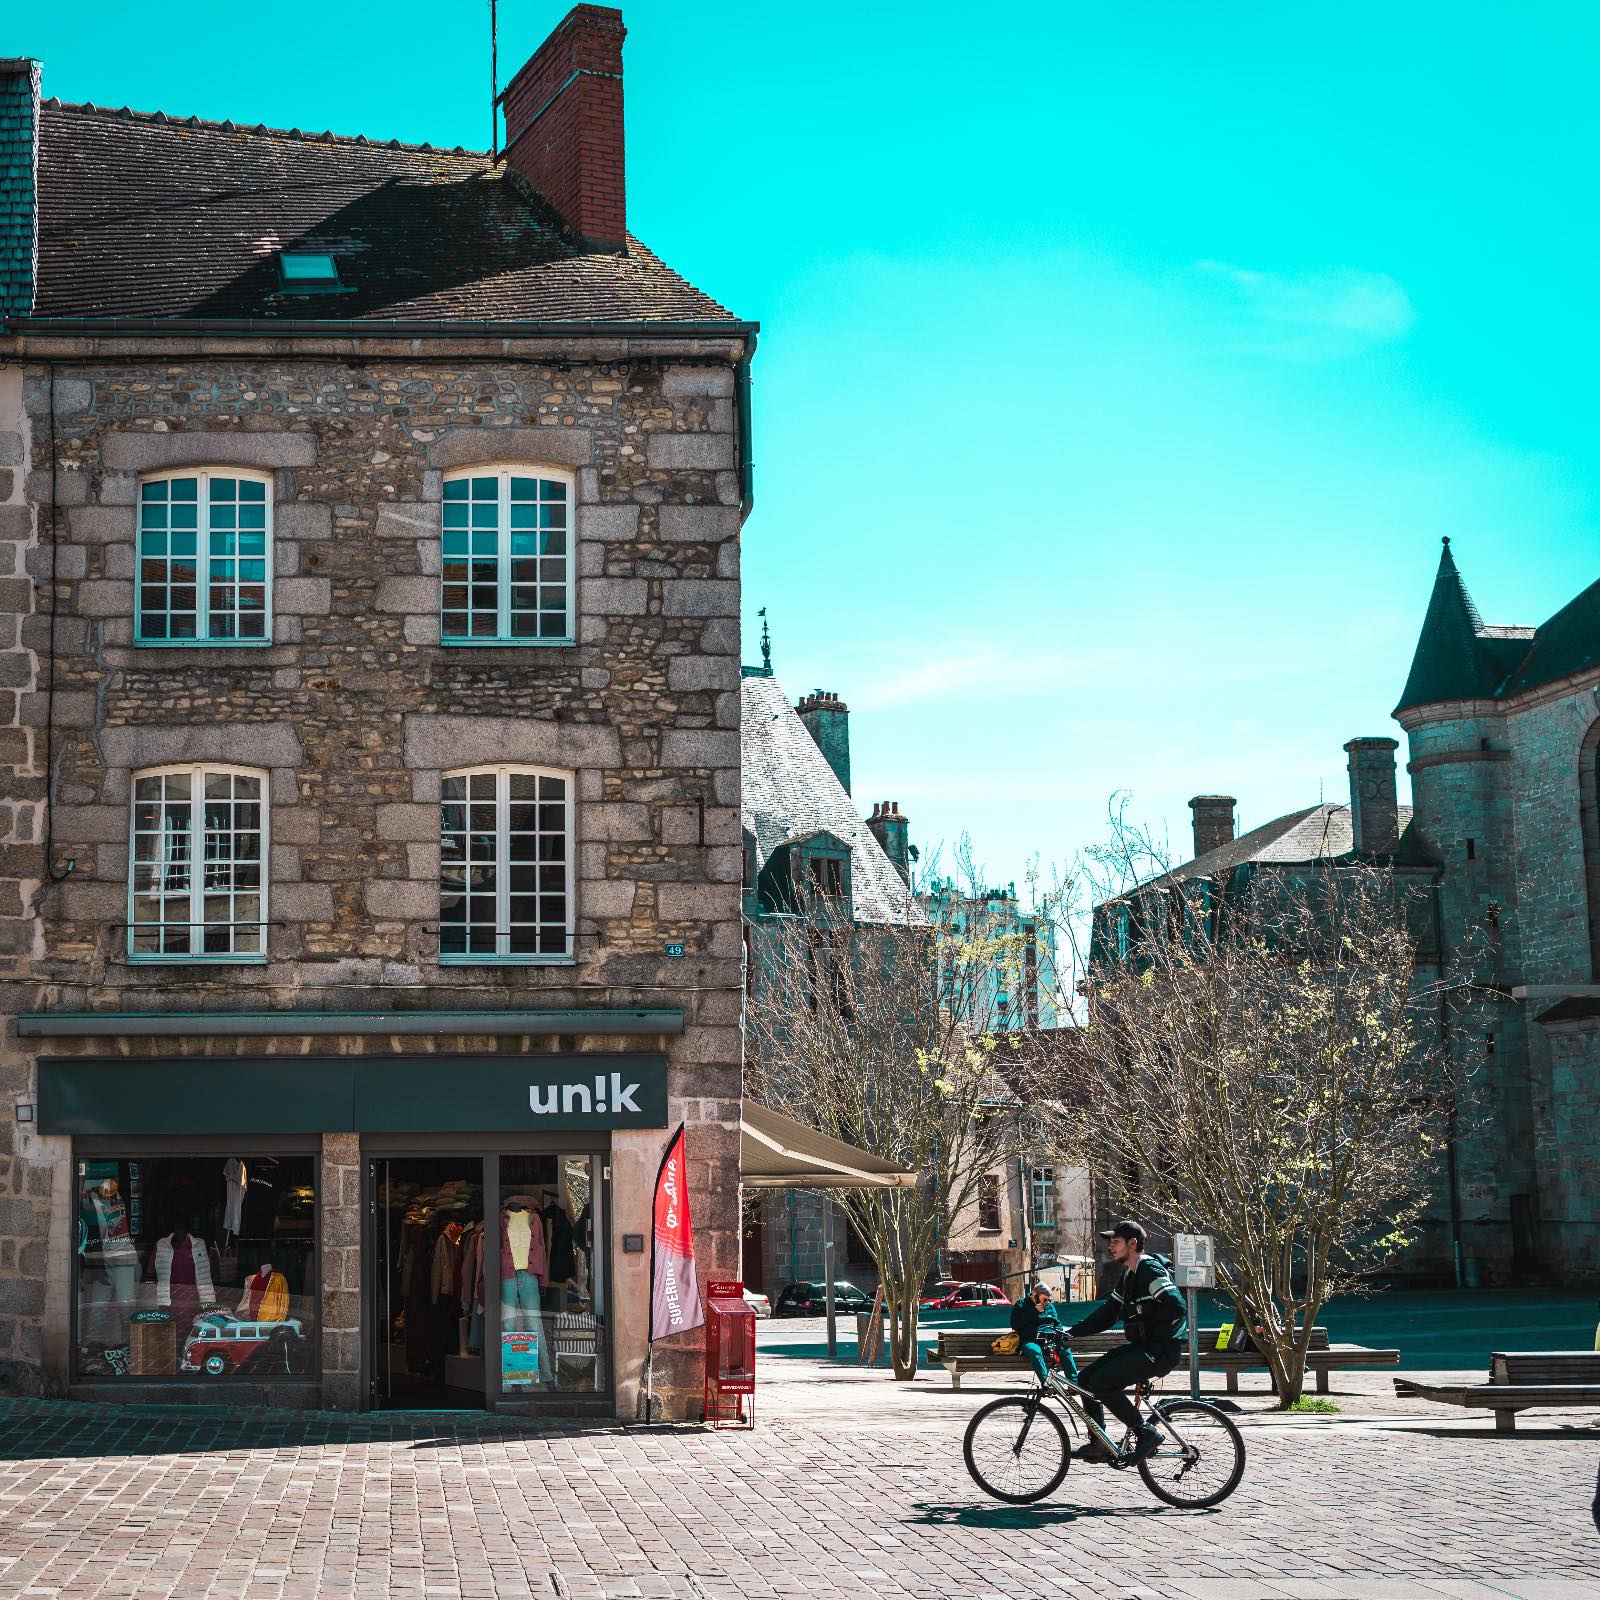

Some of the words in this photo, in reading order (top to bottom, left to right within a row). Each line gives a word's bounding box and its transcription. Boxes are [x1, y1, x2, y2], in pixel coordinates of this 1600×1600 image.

[669, 946, 682, 955] 49
[529, 1072, 643, 1114] un!k
[665, 1260, 683, 1326] SUPERDRY
